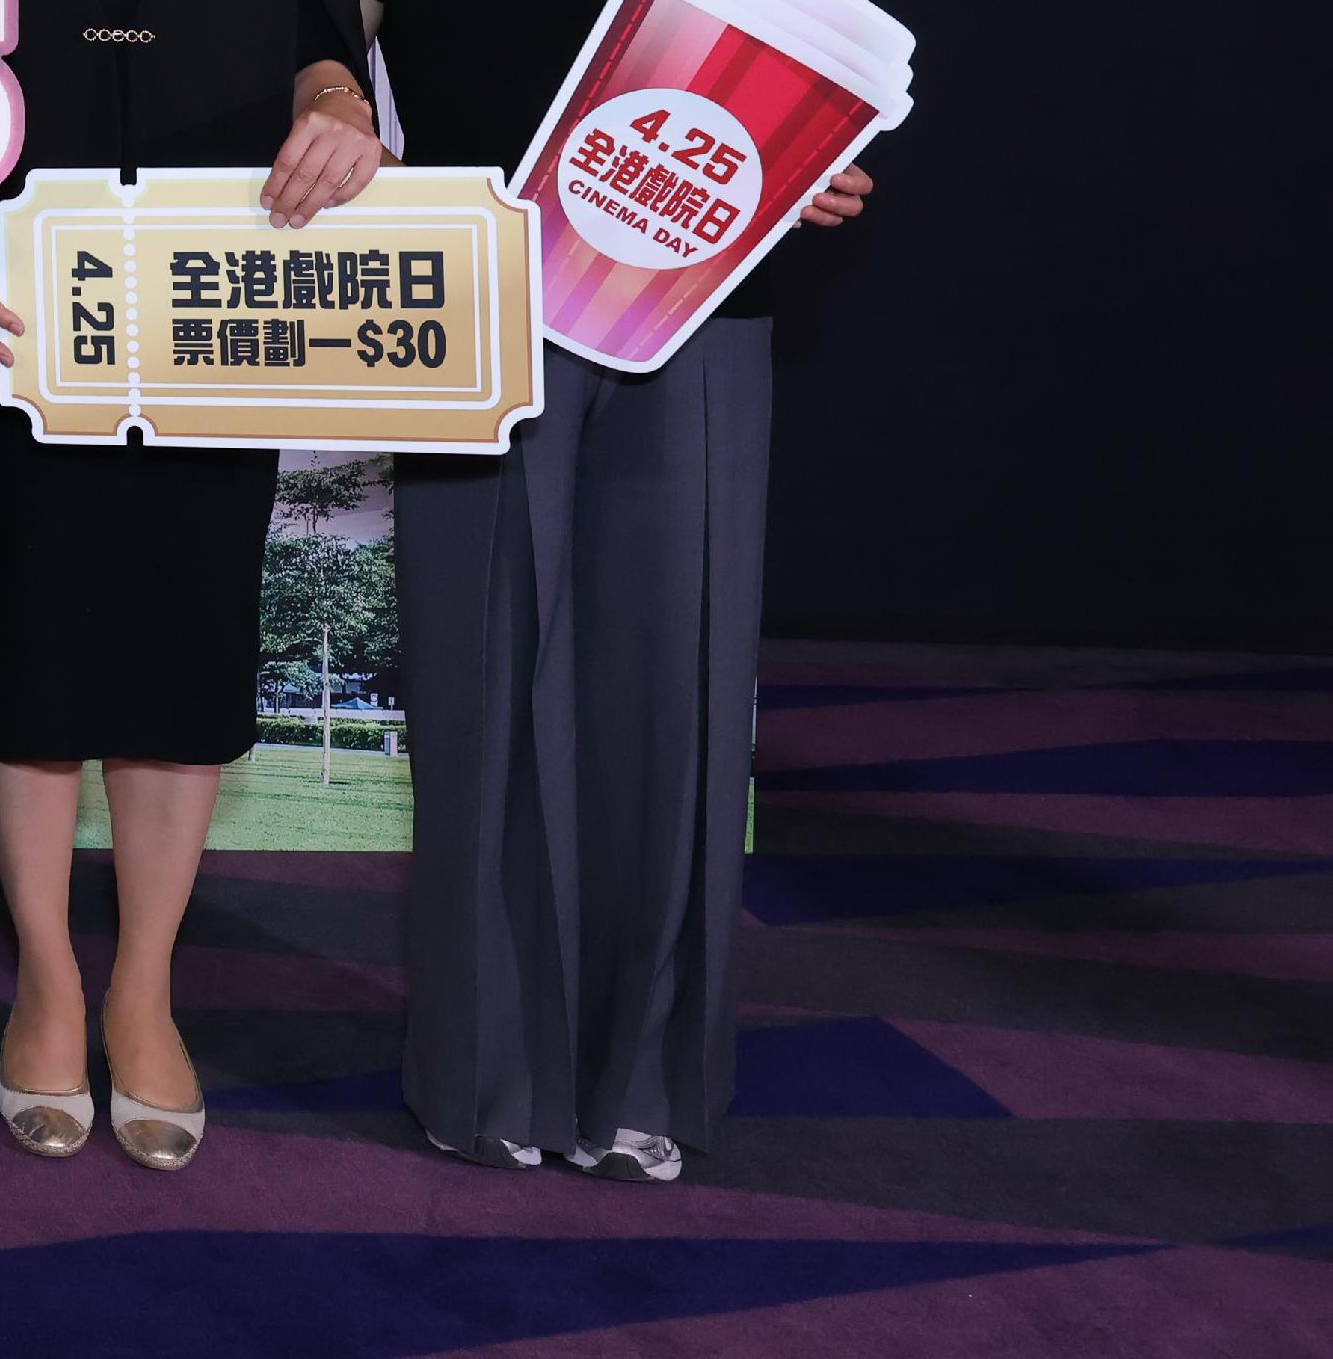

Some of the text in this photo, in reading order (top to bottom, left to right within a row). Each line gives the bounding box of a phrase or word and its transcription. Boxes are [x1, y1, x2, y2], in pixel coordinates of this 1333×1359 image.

[629, 109, 747, 185] 4.25
[568, 179, 698, 258] CINEMA DAY
[569, 128, 741, 244] 全港戲院日
[70, 251, 116, 367] 4.25
[170, 250, 446, 311] 全港戲院日
[172, 318, 447, 370] 票價劃一$30
